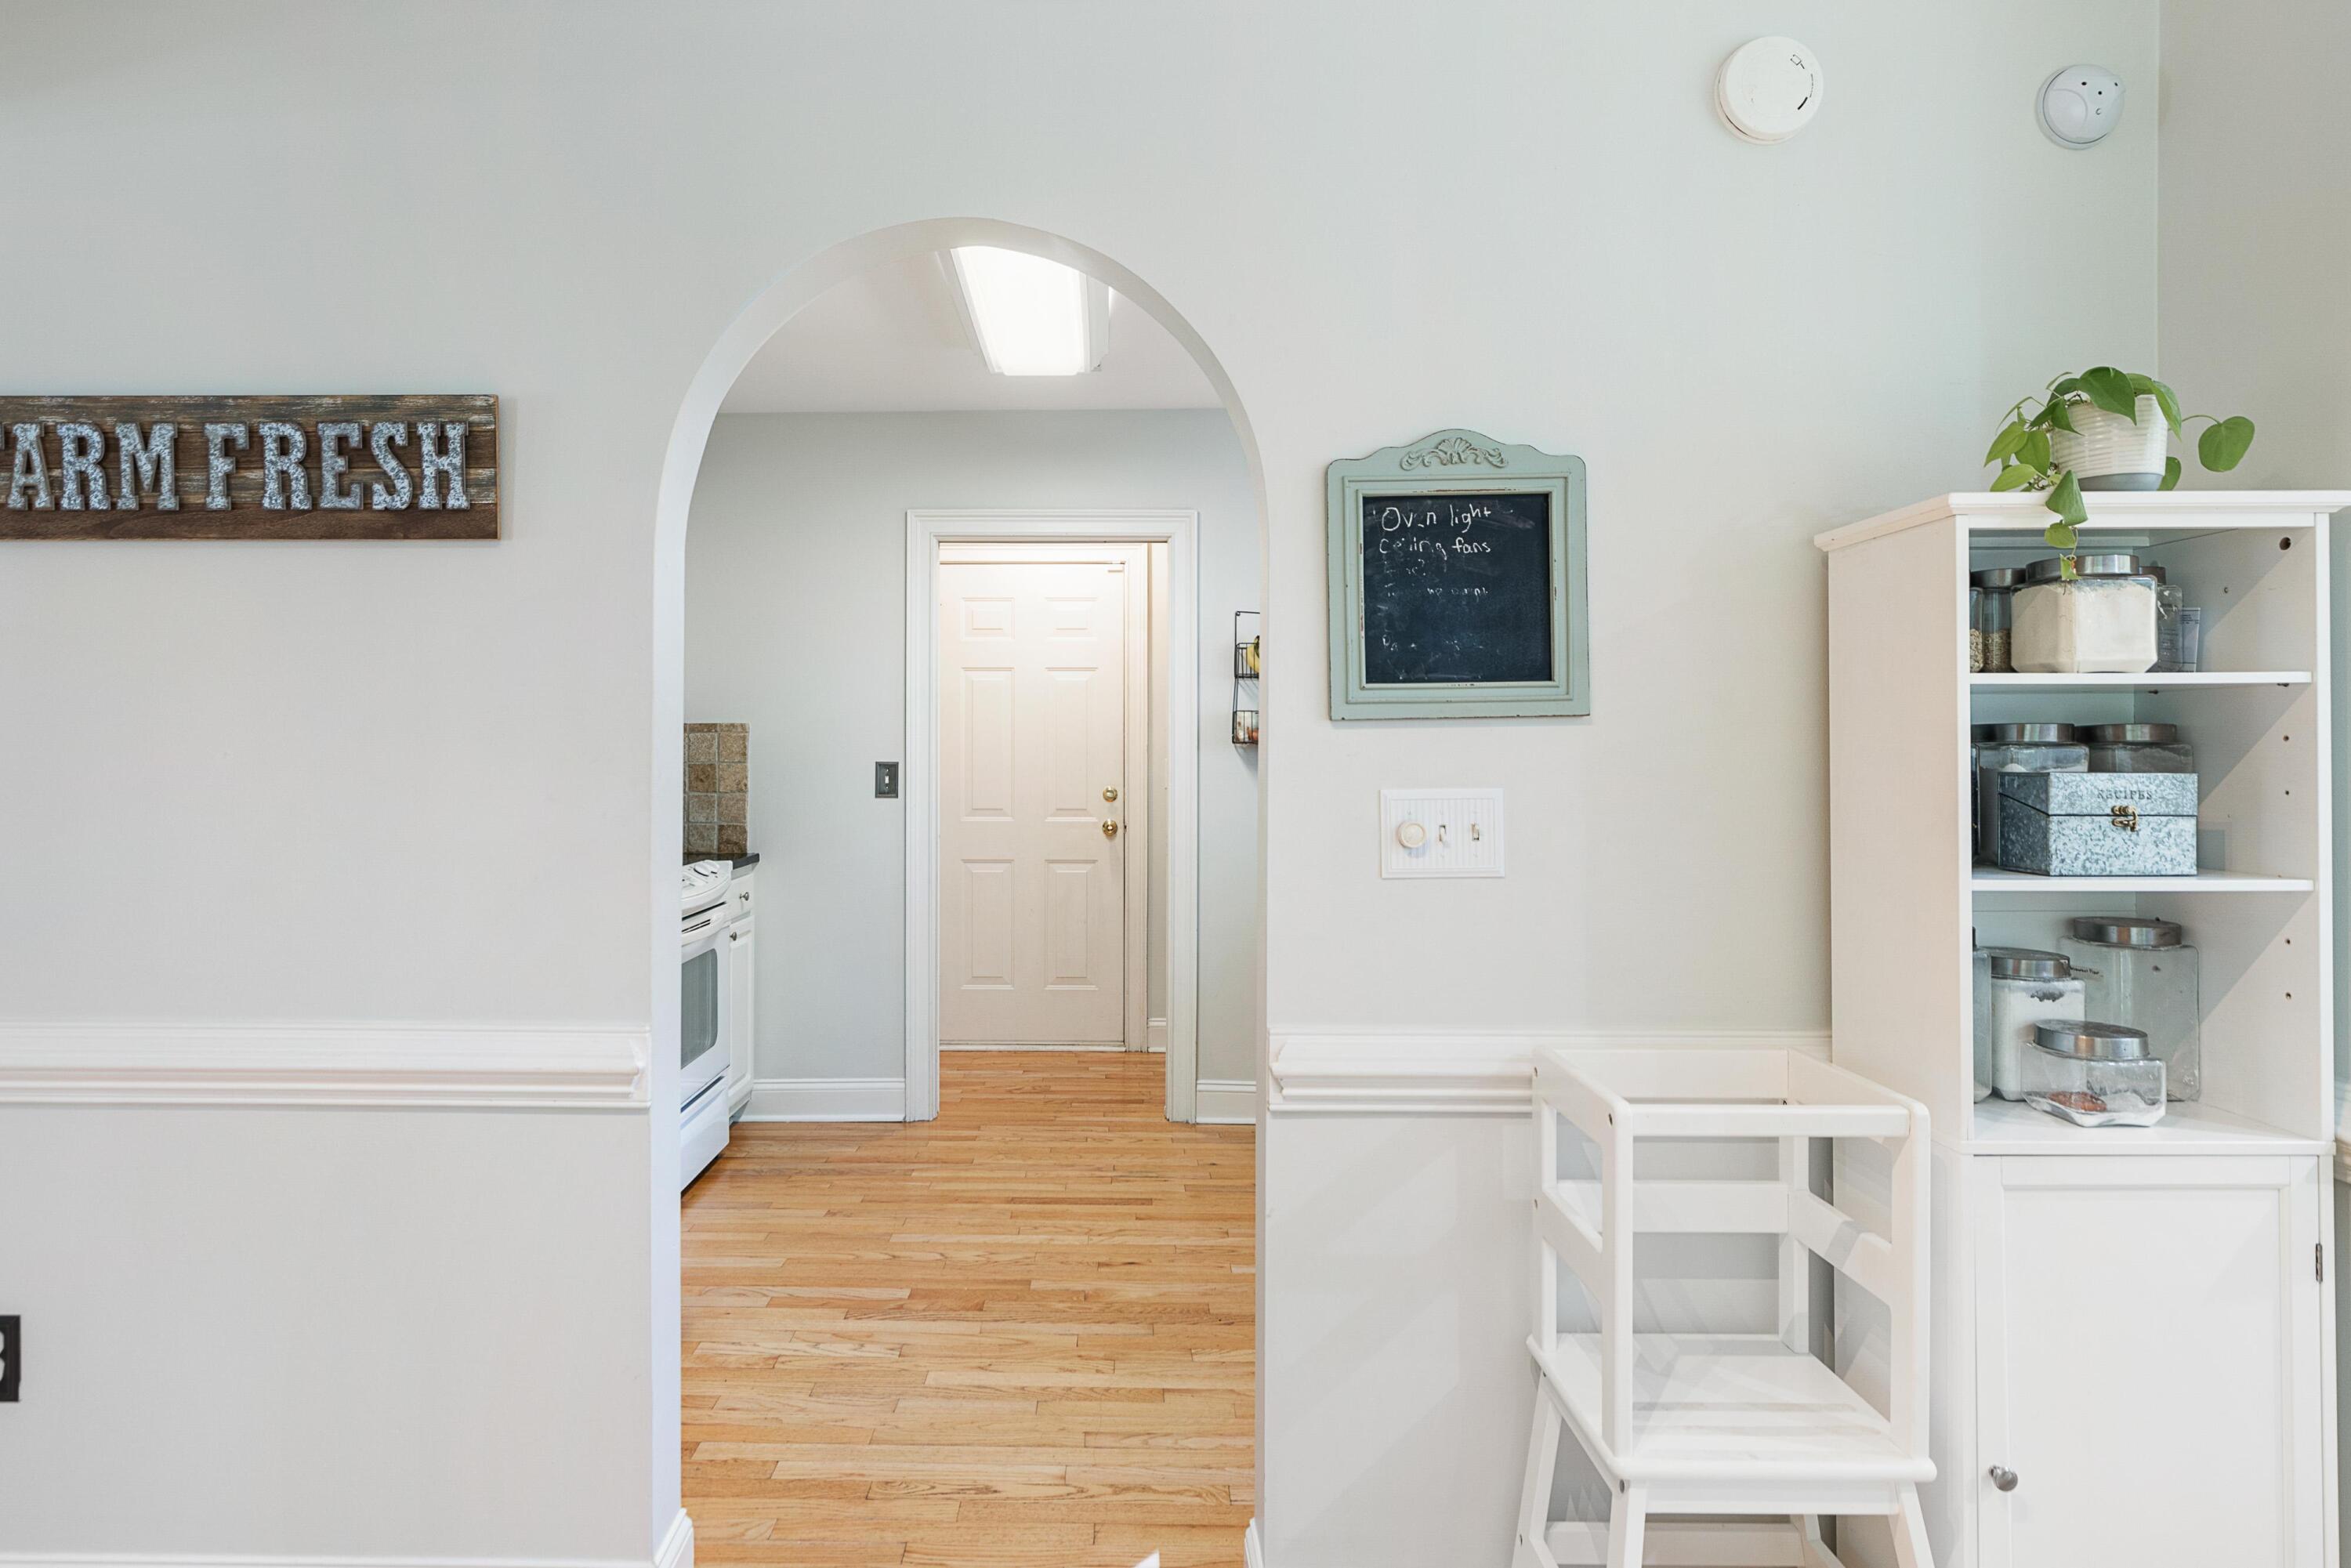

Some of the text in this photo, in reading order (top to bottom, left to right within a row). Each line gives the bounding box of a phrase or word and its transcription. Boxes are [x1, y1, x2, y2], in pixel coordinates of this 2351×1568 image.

[0, 421, 469, 511] ARM FRESH
[1450, 503, 1491, 533] light
[1451, 537, 1491, 553] fans
[2097, 789, 2153, 800] RECIPES
